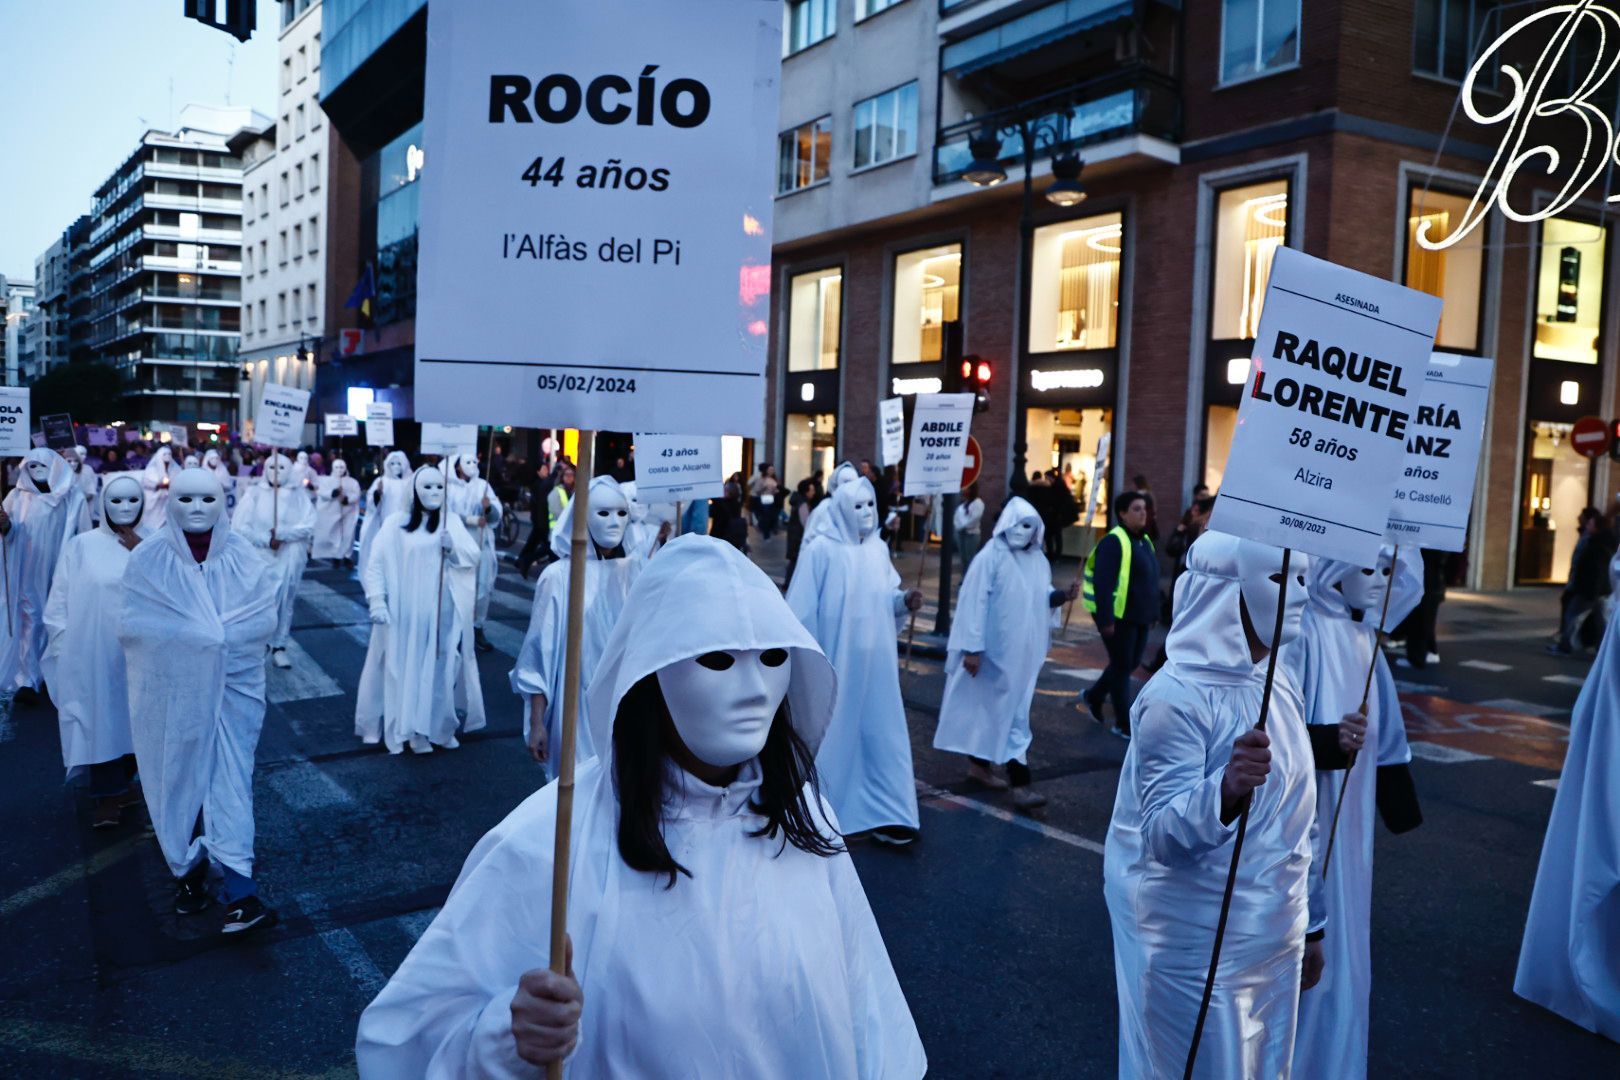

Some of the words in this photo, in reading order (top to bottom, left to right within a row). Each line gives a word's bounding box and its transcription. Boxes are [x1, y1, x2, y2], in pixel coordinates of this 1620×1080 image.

[489, 65, 710, 128] ROCÍO
[521, 157, 565, 188] 44
[576, 159, 671, 192] años
[503, 233, 588, 261] l'Alfàs
[598, 237, 641, 264] del
[653, 239, 681, 265] Pi
[1334, 293, 1380, 315] ASESINADA
[1272, 330, 1407, 397] RAQUEL
[537, 374, 636, 393] 05/02/2024
[1251, 370, 1410, 441] LORENTE
[921, 422, 963, 432] ABDILE
[1413, 404, 1461, 430] RÍA
[661, 449, 673, 457] 43
[675, 448, 699, 457] años
[920, 437, 961, 447] YOSITE
[1289, 427, 1312, 448] 58
[1314, 437, 1359, 462] años
[648, 466, 669, 474] costa
[682, 463, 711, 471] Alicante
[1294, 467, 1333, 490] Alzira
[1404, 466, 1439, 480] años
[1409, 490, 1452, 505] Castelló
[1279, 515, 1326, 535] 30/08/2023
